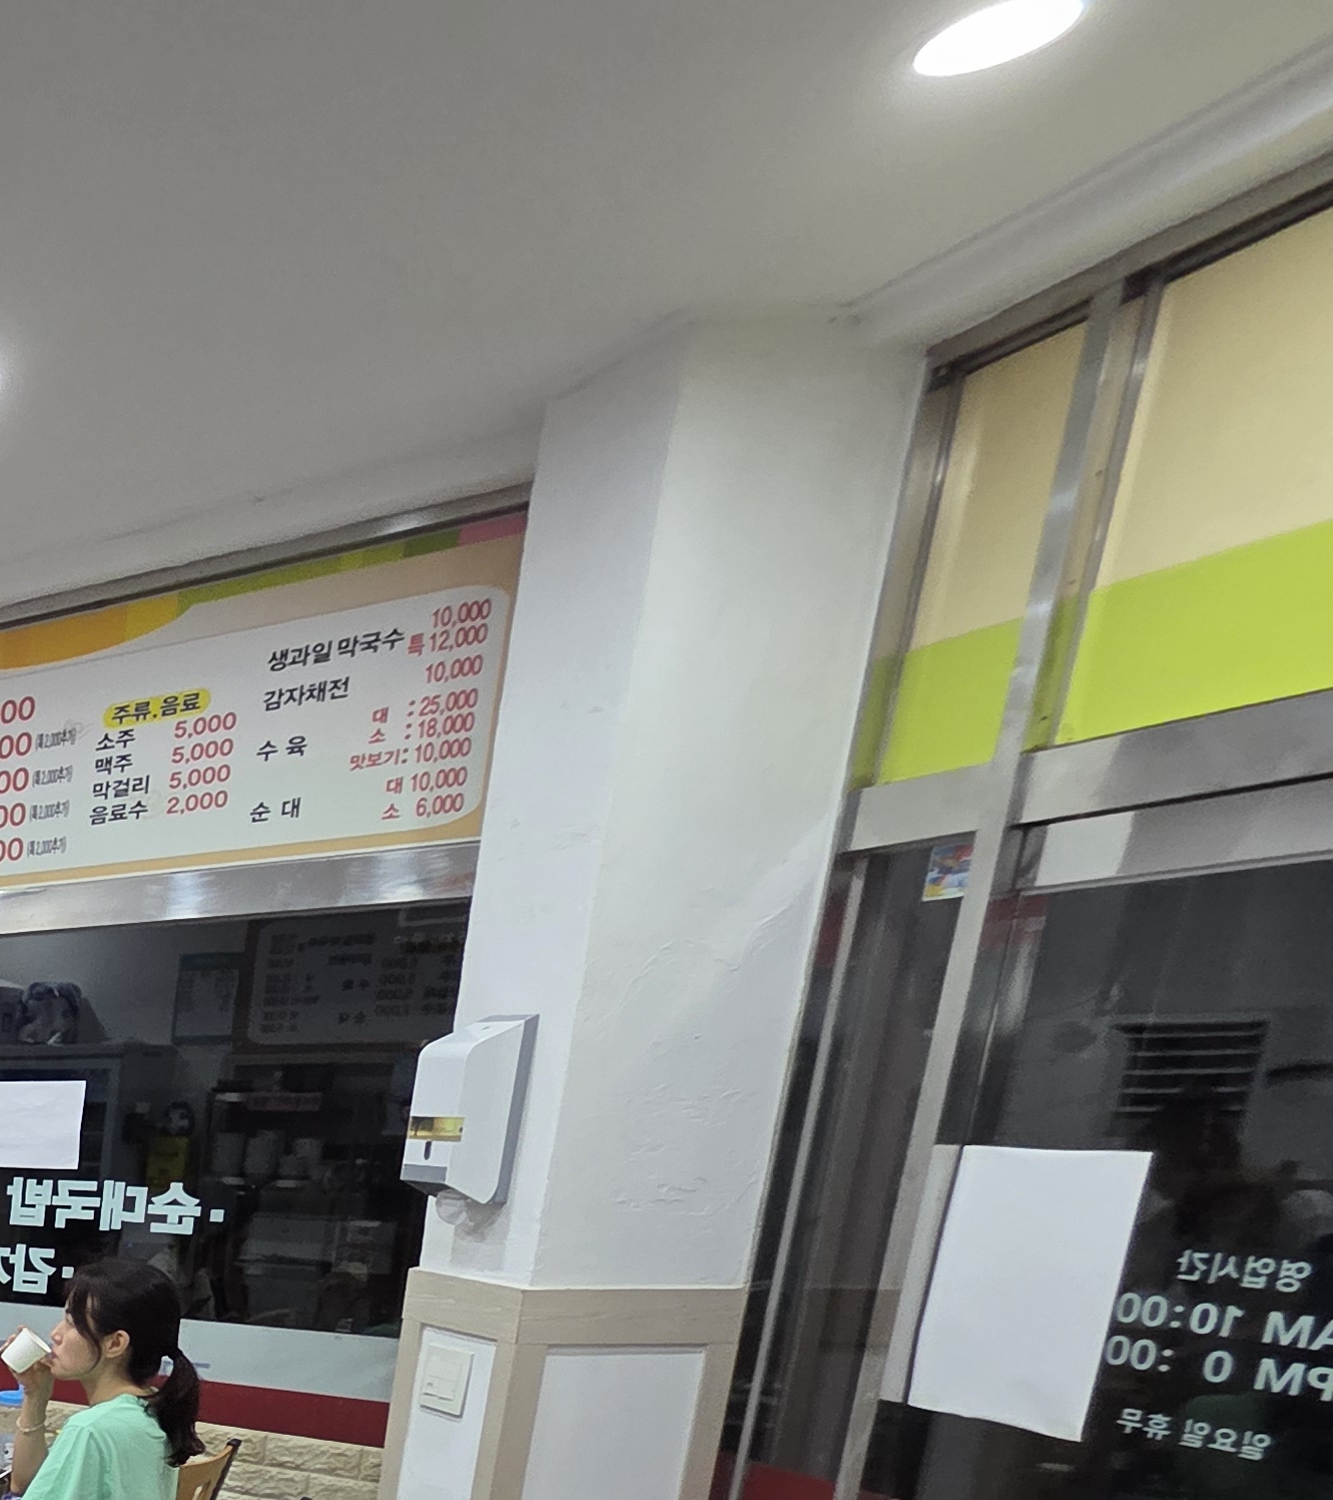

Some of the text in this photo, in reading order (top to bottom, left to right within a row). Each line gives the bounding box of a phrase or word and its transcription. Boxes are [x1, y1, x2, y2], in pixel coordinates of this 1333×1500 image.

[433, 599, 492, 628] 10,000
[268, 640, 333, 671] 생과일
[338, 628, 405, 657] 막국수
[429, 623, 488, 652] 12,000
[264, 655, 483, 712] 감자채전 10,000
[372, 688, 478, 724] 대 25,000
[96, 712, 236, 751] 소주 5,000
[368, 712, 475, 744] 소 18,000
[95, 738, 234, 774] 맥주 5,000
[414, 737, 472, 763] 10,000
[92, 764, 231, 800] 막걸리 5,000
[386, 766, 467, 794] 대 10,000
[89, 790, 228, 825] 음료수 2,000
[381, 793, 465, 820] 소 6,000
